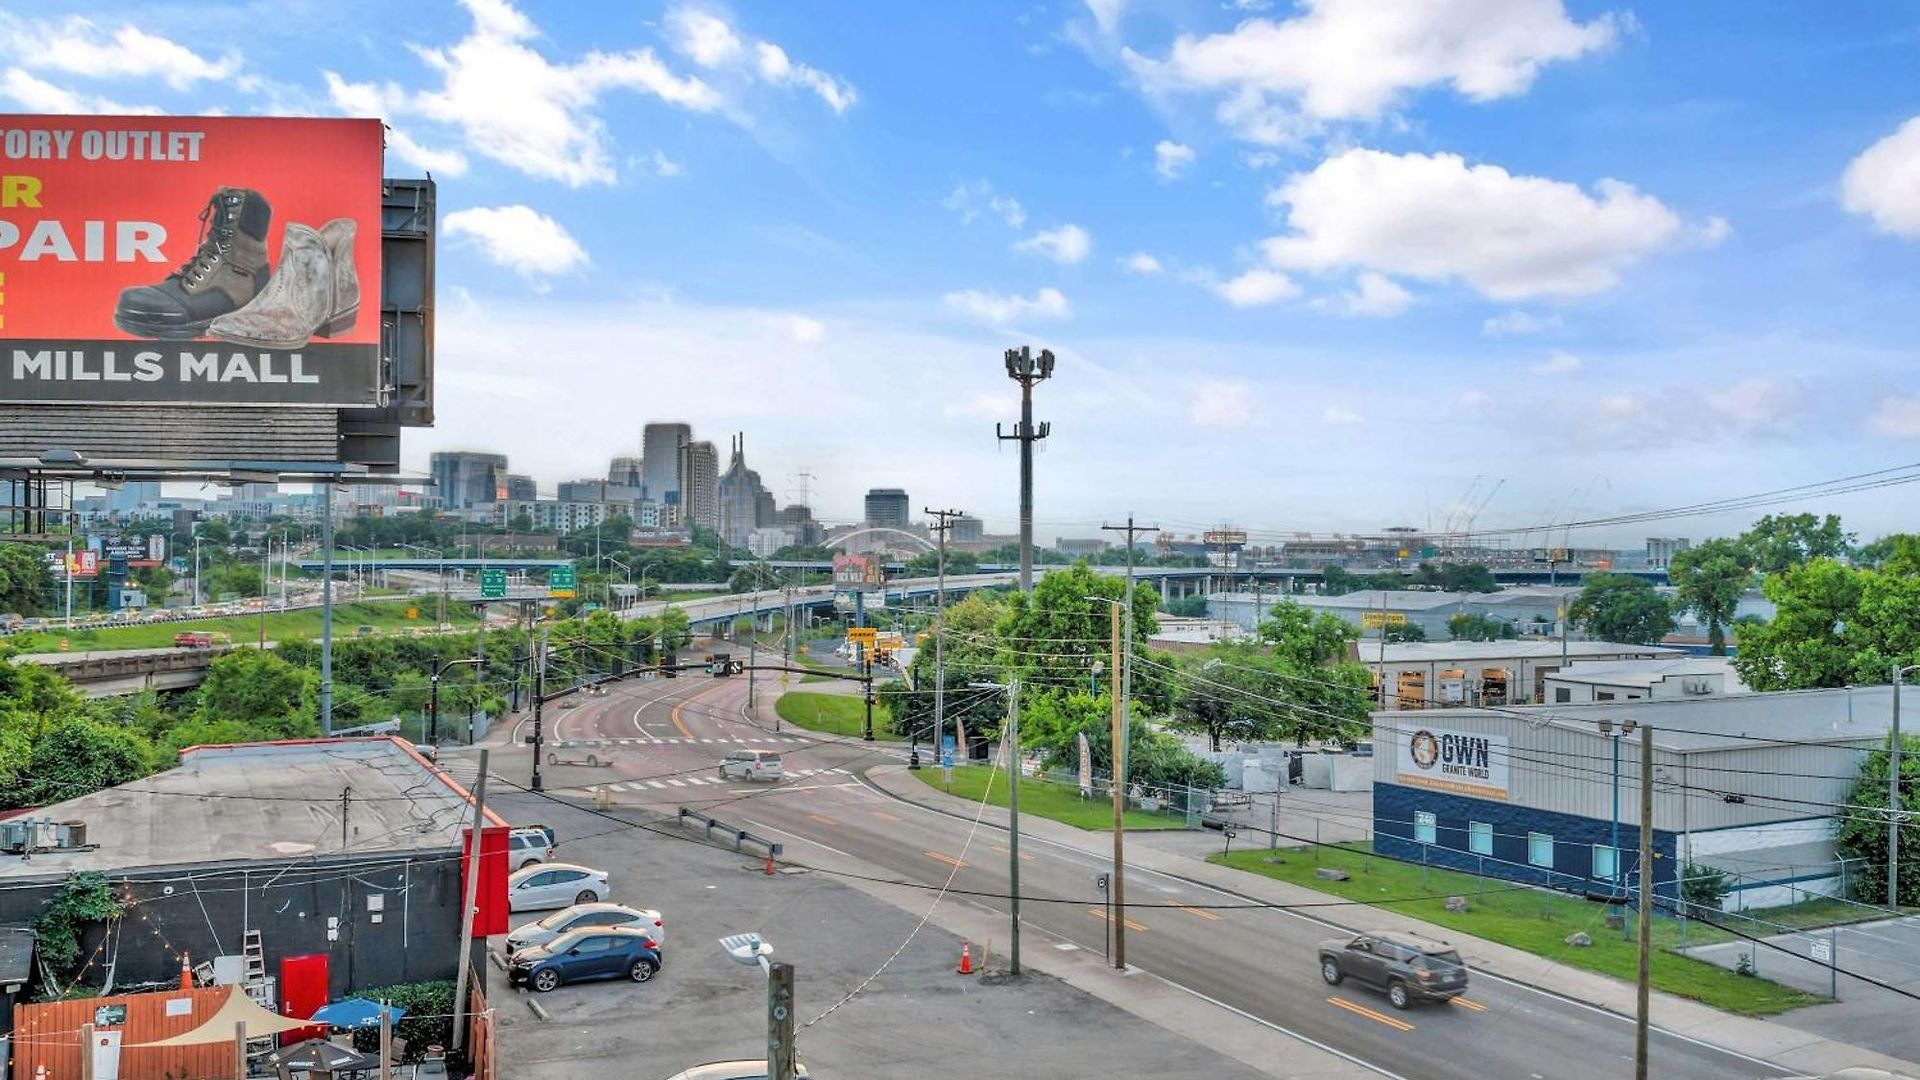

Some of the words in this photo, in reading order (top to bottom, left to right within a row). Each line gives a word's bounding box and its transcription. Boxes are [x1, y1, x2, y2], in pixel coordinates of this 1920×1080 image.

[0, 129, 74, 159] ORY
[81, 130, 205, 161] OUTLET
[13, 350, 164, 382] MILLS
[179, 352, 320, 383] MALL
[1442, 734, 1489, 768] GWN
[1442, 764, 1467, 776] GRANITE
[1467, 768, 1490, 780] WORLD
